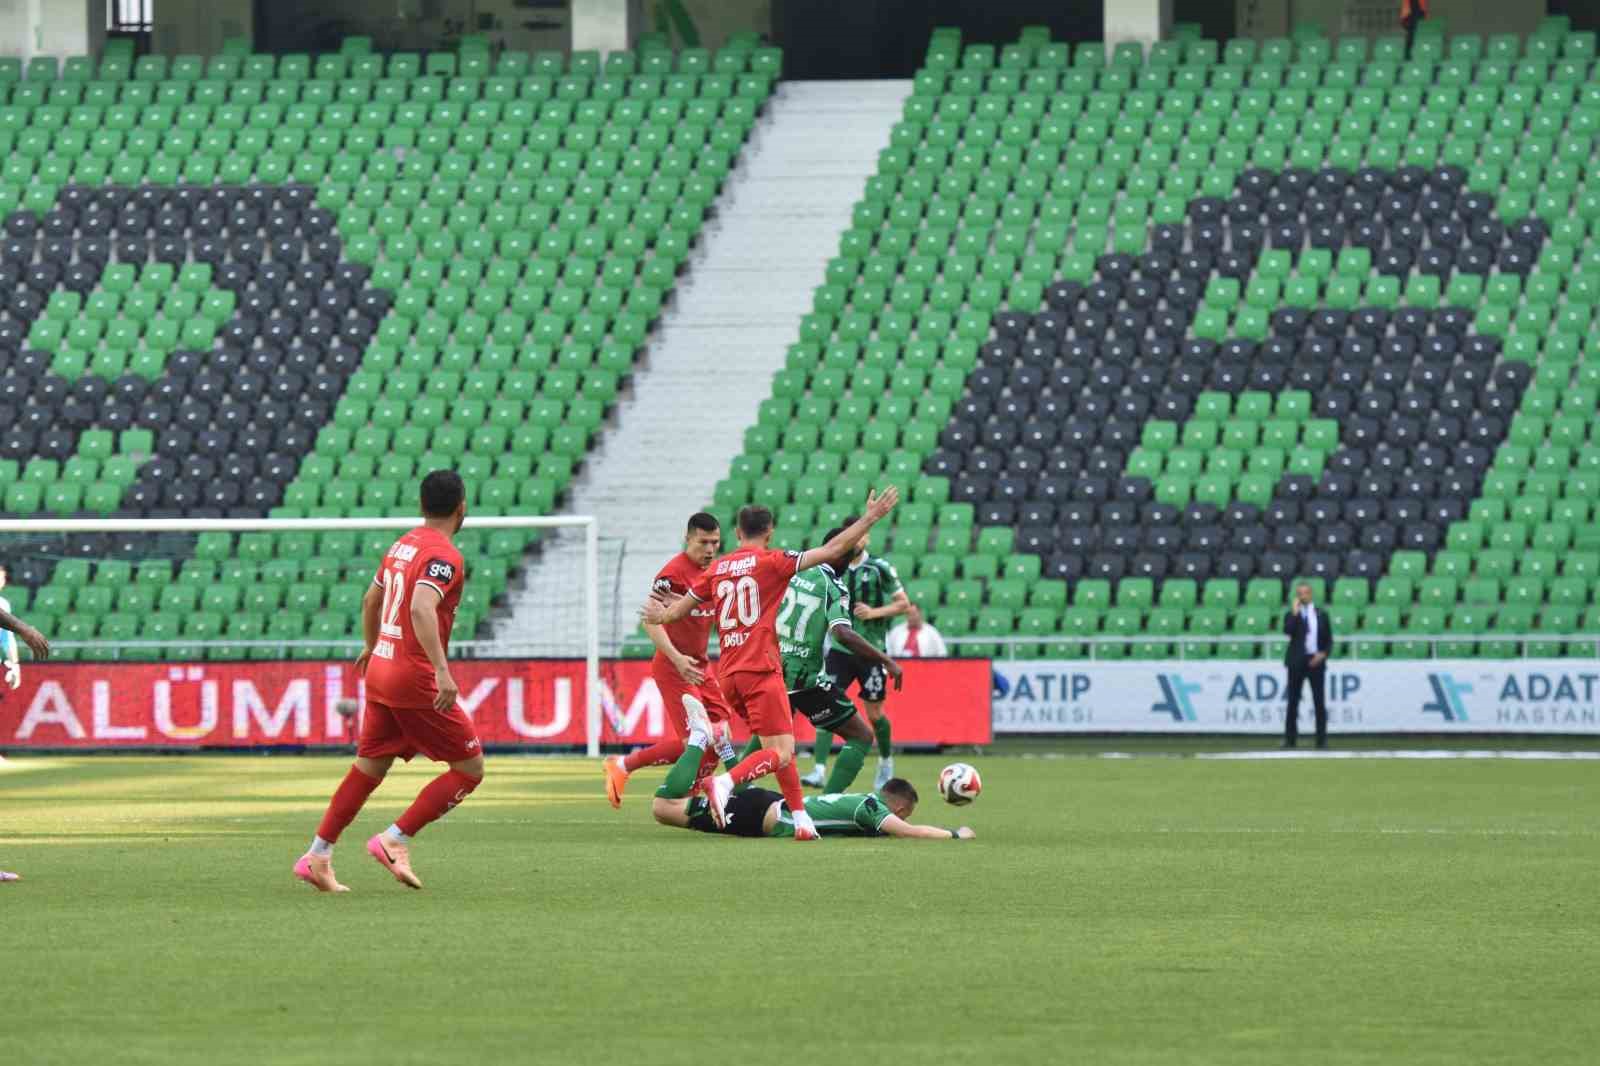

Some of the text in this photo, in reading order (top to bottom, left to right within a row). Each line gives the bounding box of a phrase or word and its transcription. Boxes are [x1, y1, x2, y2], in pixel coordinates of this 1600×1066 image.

[716, 575, 760, 630] 20
[775, 586, 821, 641] 27
[16, 665, 664, 738] ALÜMİYUM
[864, 675, 883, 691] 43
[1227, 674, 1361, 701] ADIP
